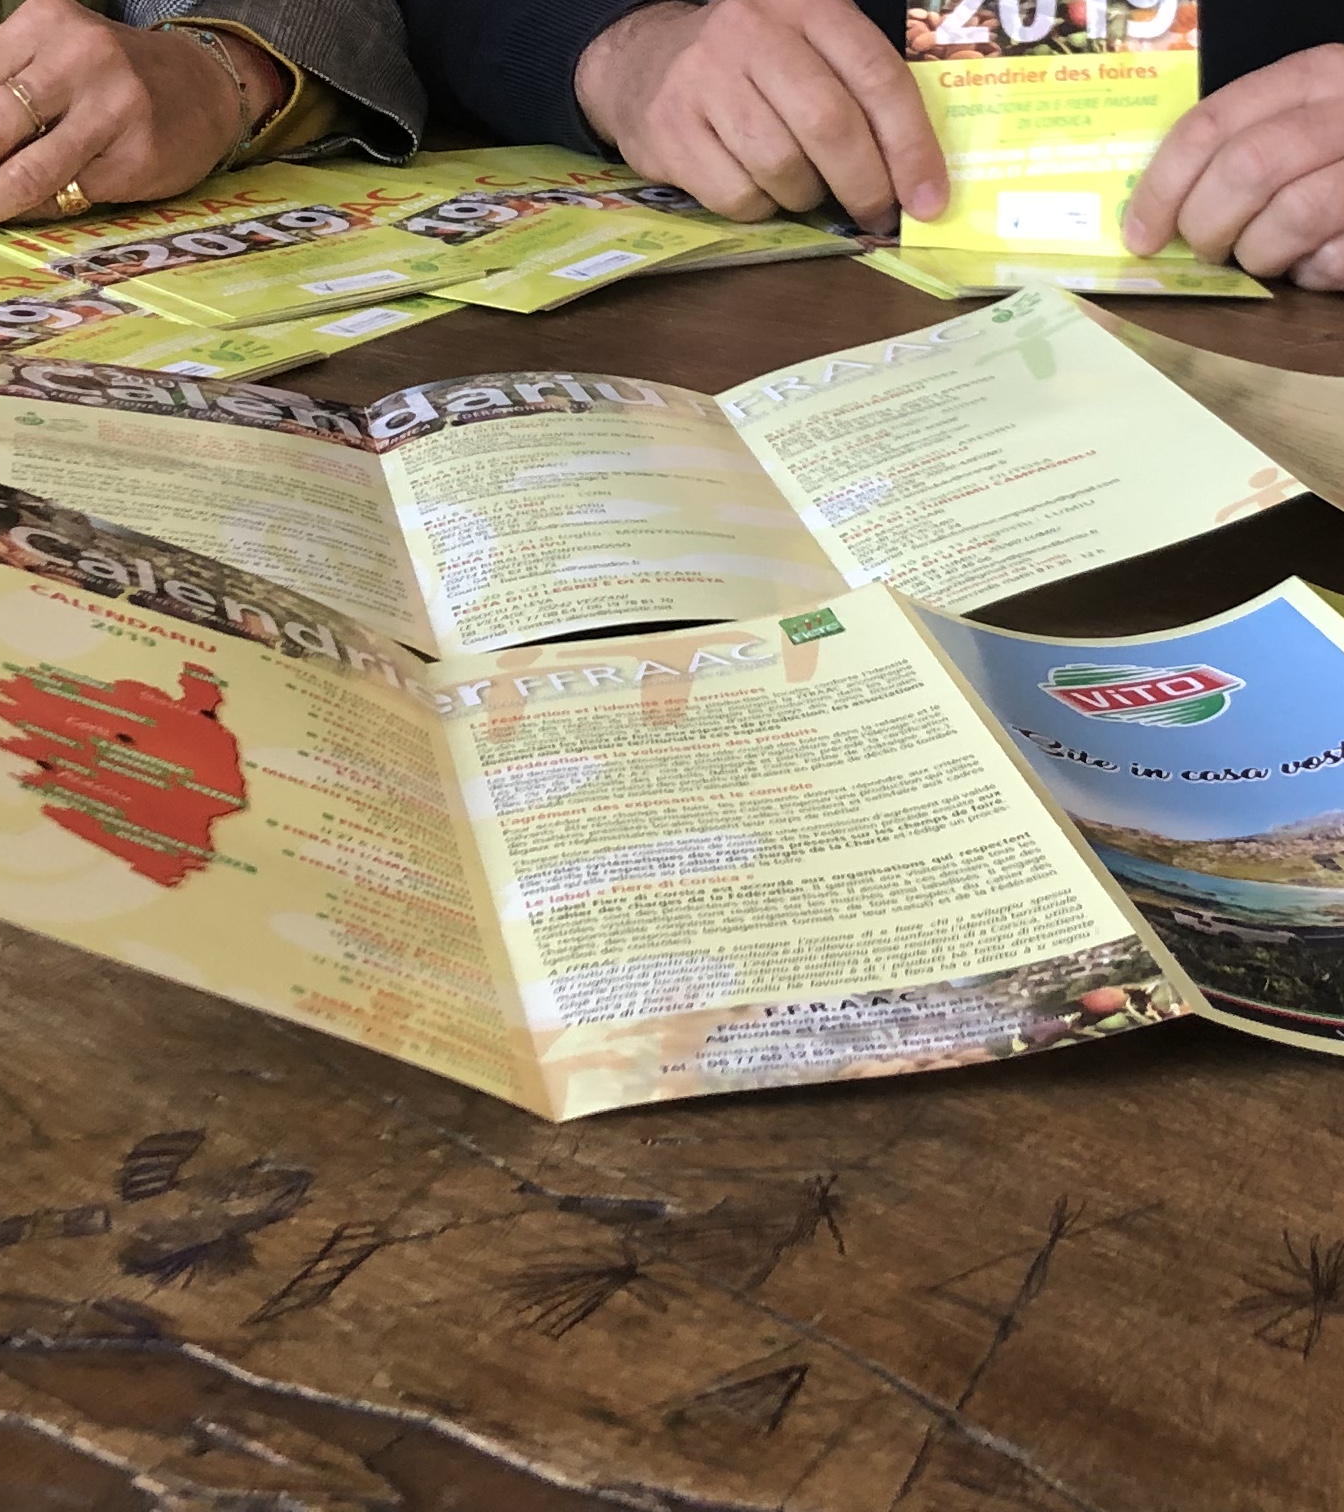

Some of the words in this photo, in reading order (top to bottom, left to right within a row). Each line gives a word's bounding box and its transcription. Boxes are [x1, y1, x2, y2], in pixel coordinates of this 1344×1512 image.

[940, 65, 1048, 88] Calendrier
[1054, 64, 1093, 84] des
[1098, 63, 1158, 81] foires
[116, 207, 352, 277] 2019
[29, 582, 218, 654] CALENDARIU
[89, 617, 157, 649] 2019
[1070, 676, 1205, 710] ViTO
[1129, 761, 1171, 781] in
[1180, 765, 1269, 782] casa
